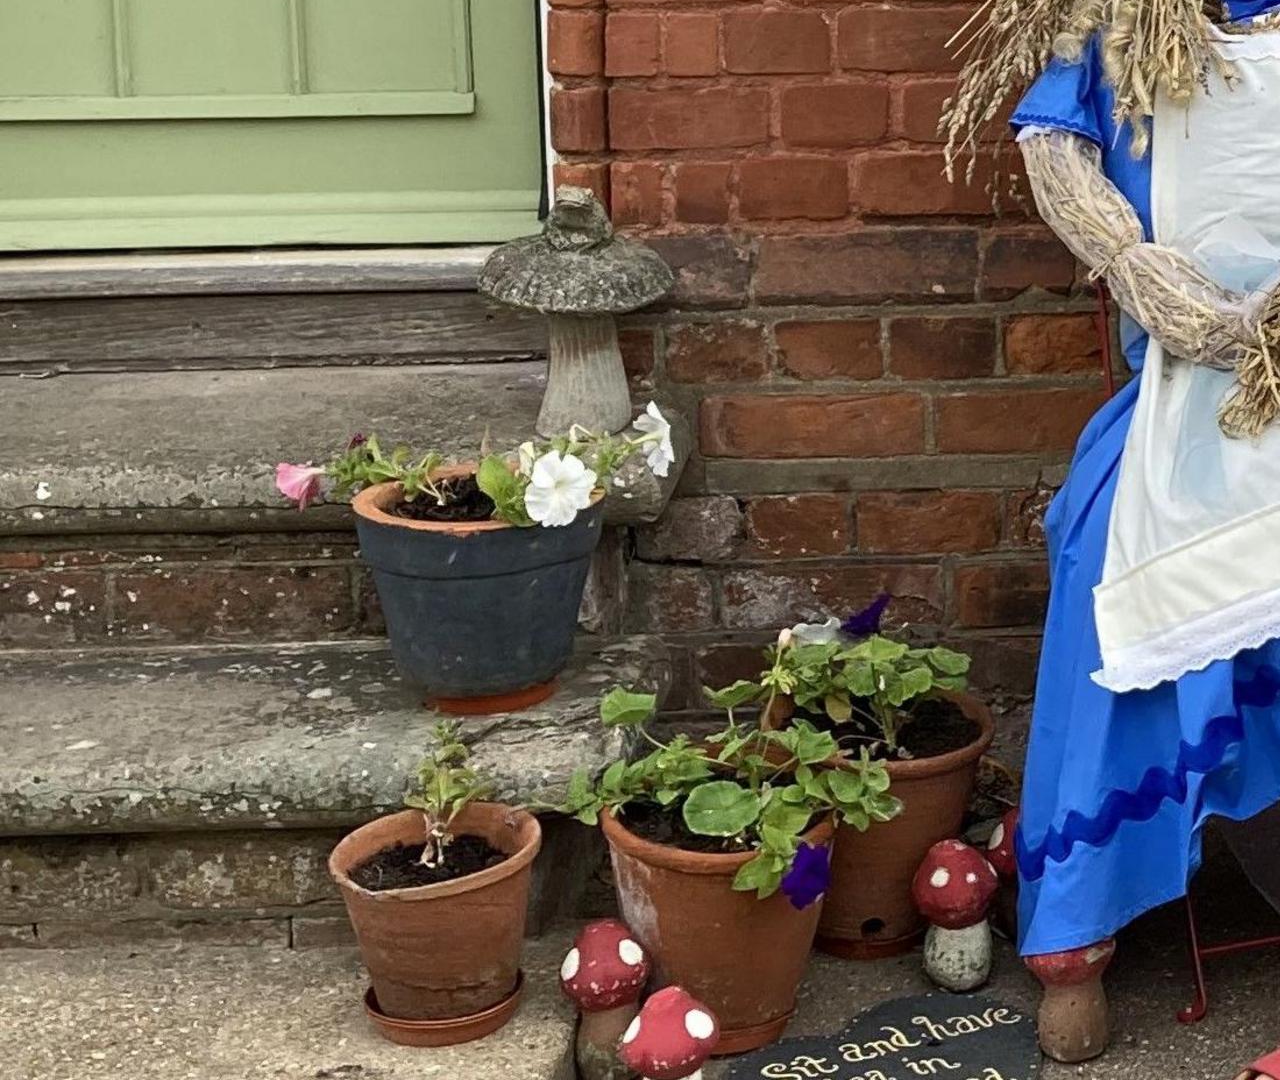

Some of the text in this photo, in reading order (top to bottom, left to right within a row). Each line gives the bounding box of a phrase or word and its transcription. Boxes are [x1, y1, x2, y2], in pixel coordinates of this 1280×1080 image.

[760, 1008, 1022, 1080] Sit and have
[901, 1057, 962, 1075] in
